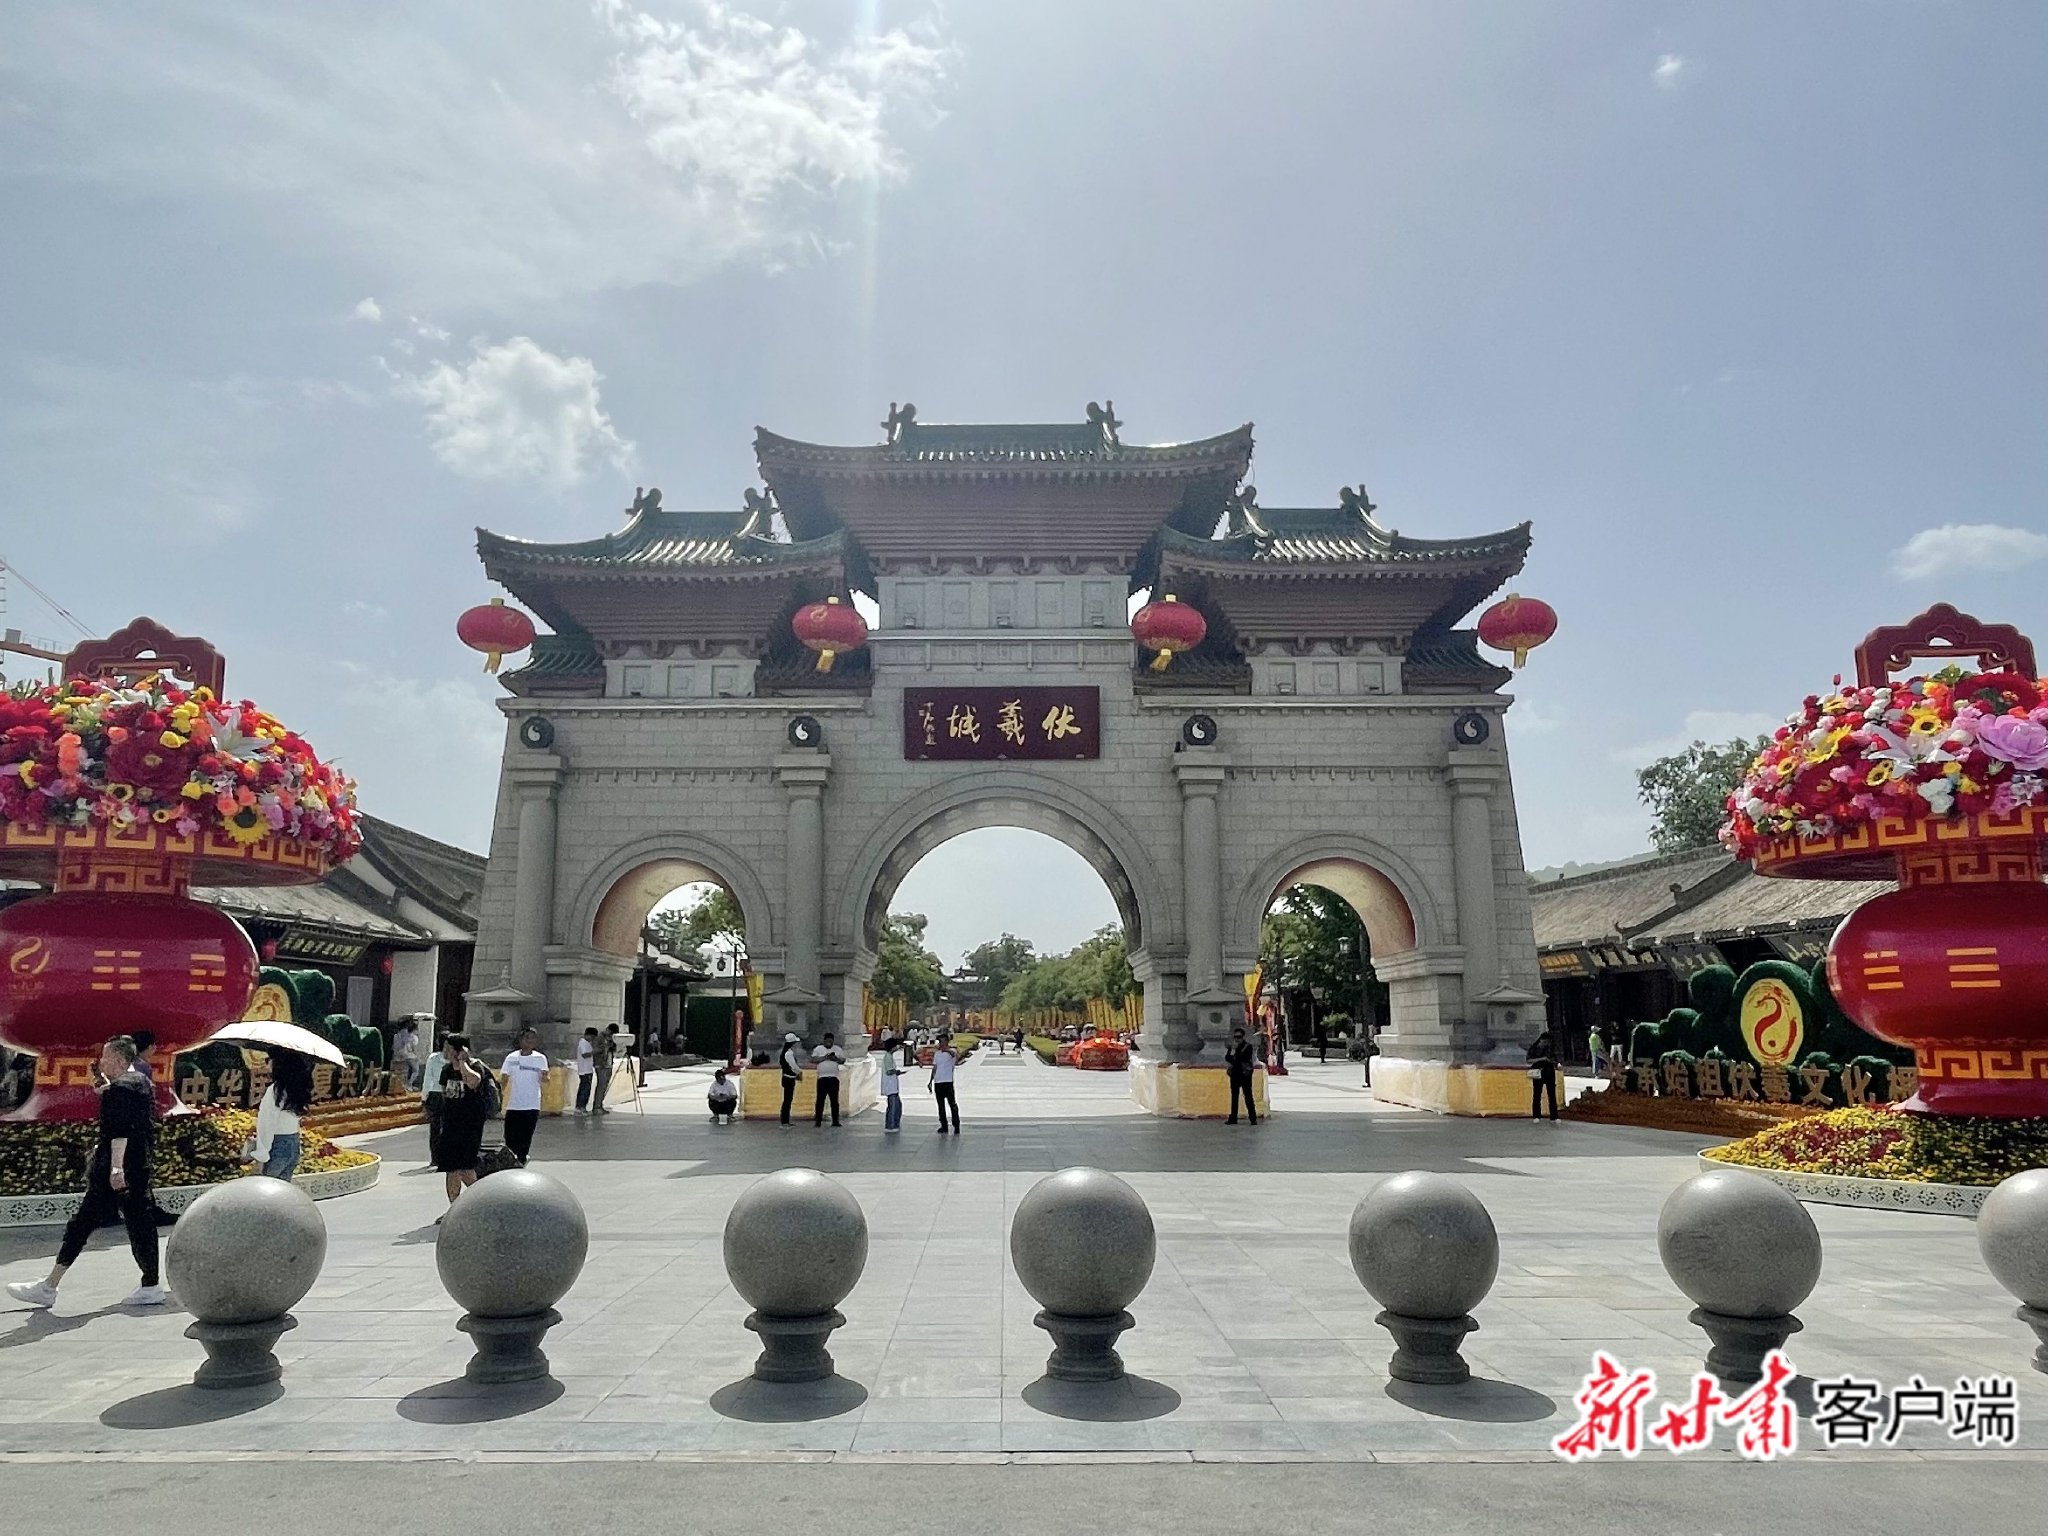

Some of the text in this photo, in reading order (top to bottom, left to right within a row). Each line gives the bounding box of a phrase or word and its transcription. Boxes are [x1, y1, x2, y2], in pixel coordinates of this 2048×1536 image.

[180, 1060, 407, 1107] 中华民复兴力量
